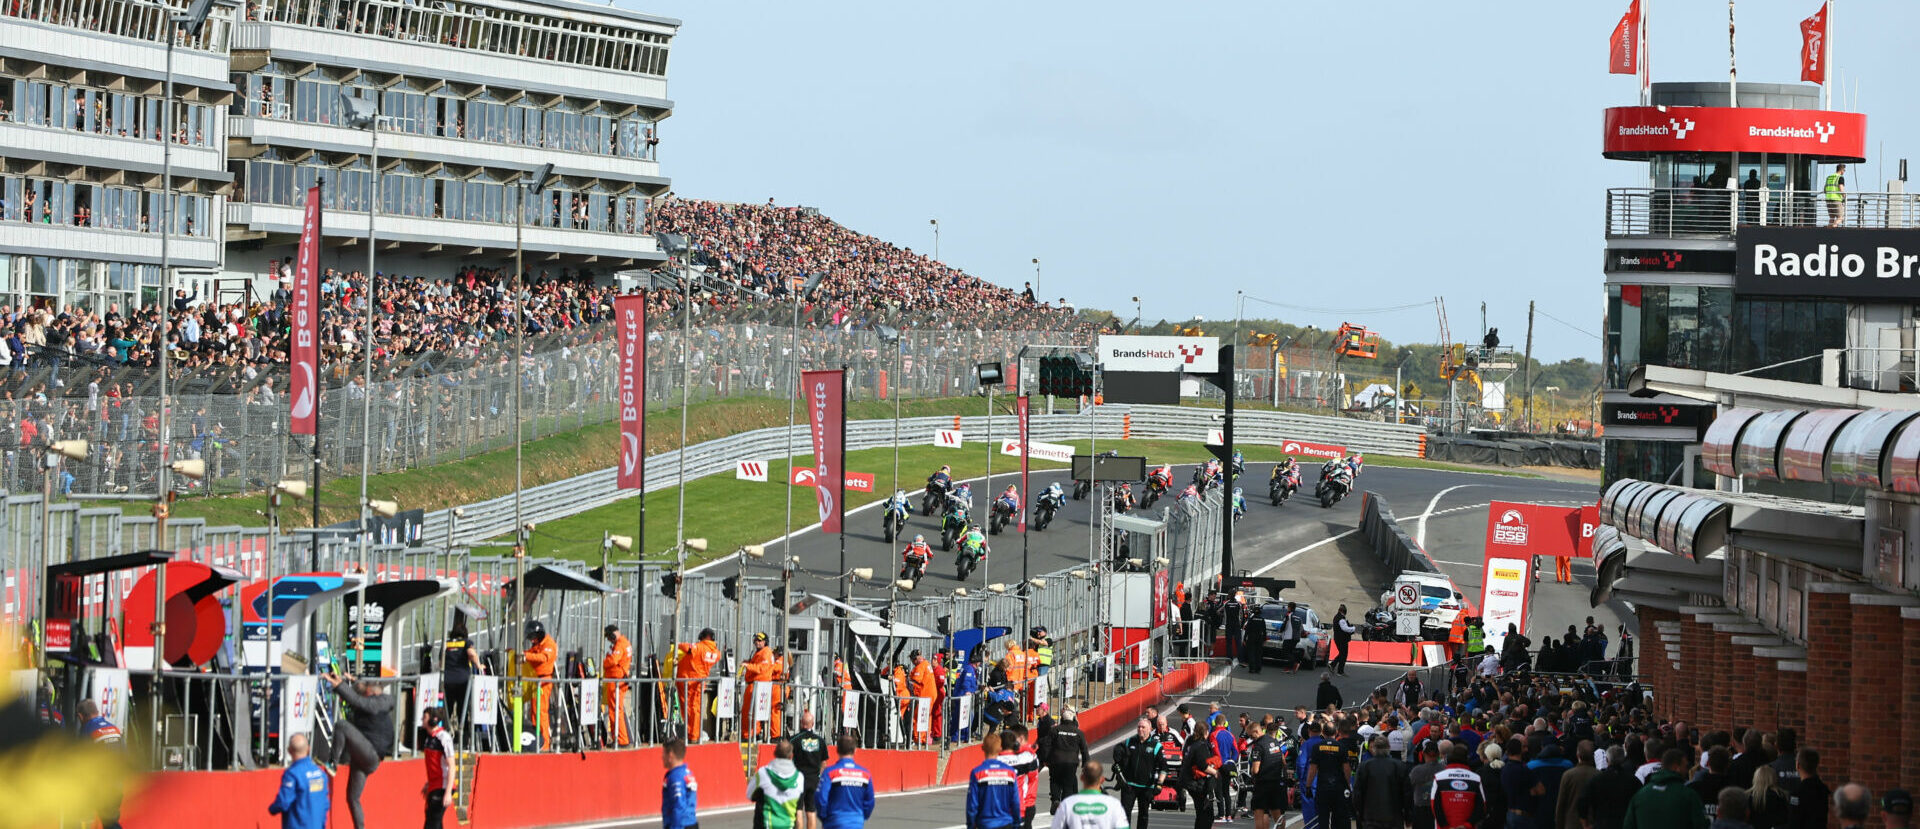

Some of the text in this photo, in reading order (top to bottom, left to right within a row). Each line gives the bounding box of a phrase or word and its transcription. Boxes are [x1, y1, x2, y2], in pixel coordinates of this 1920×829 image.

[1809, 29, 1822, 71] MSV
[1619, 125, 1668, 136] BrandsHatch
[1749, 126, 1814, 138] BrandsHatch
[1620, 256, 1660, 266] BrandsHatch
[1754, 244, 1919, 279] Radio Br
[1113, 349, 1175, 360] BrandsHatch
[1617, 409, 1657, 421] BrandsHatch
[1303, 446, 1341, 458] Bennetts
[1496, 523, 1527, 532] Bennetts
[1495, 530, 1526, 541] BSB
[1402, 588, 1412, 597] 60
